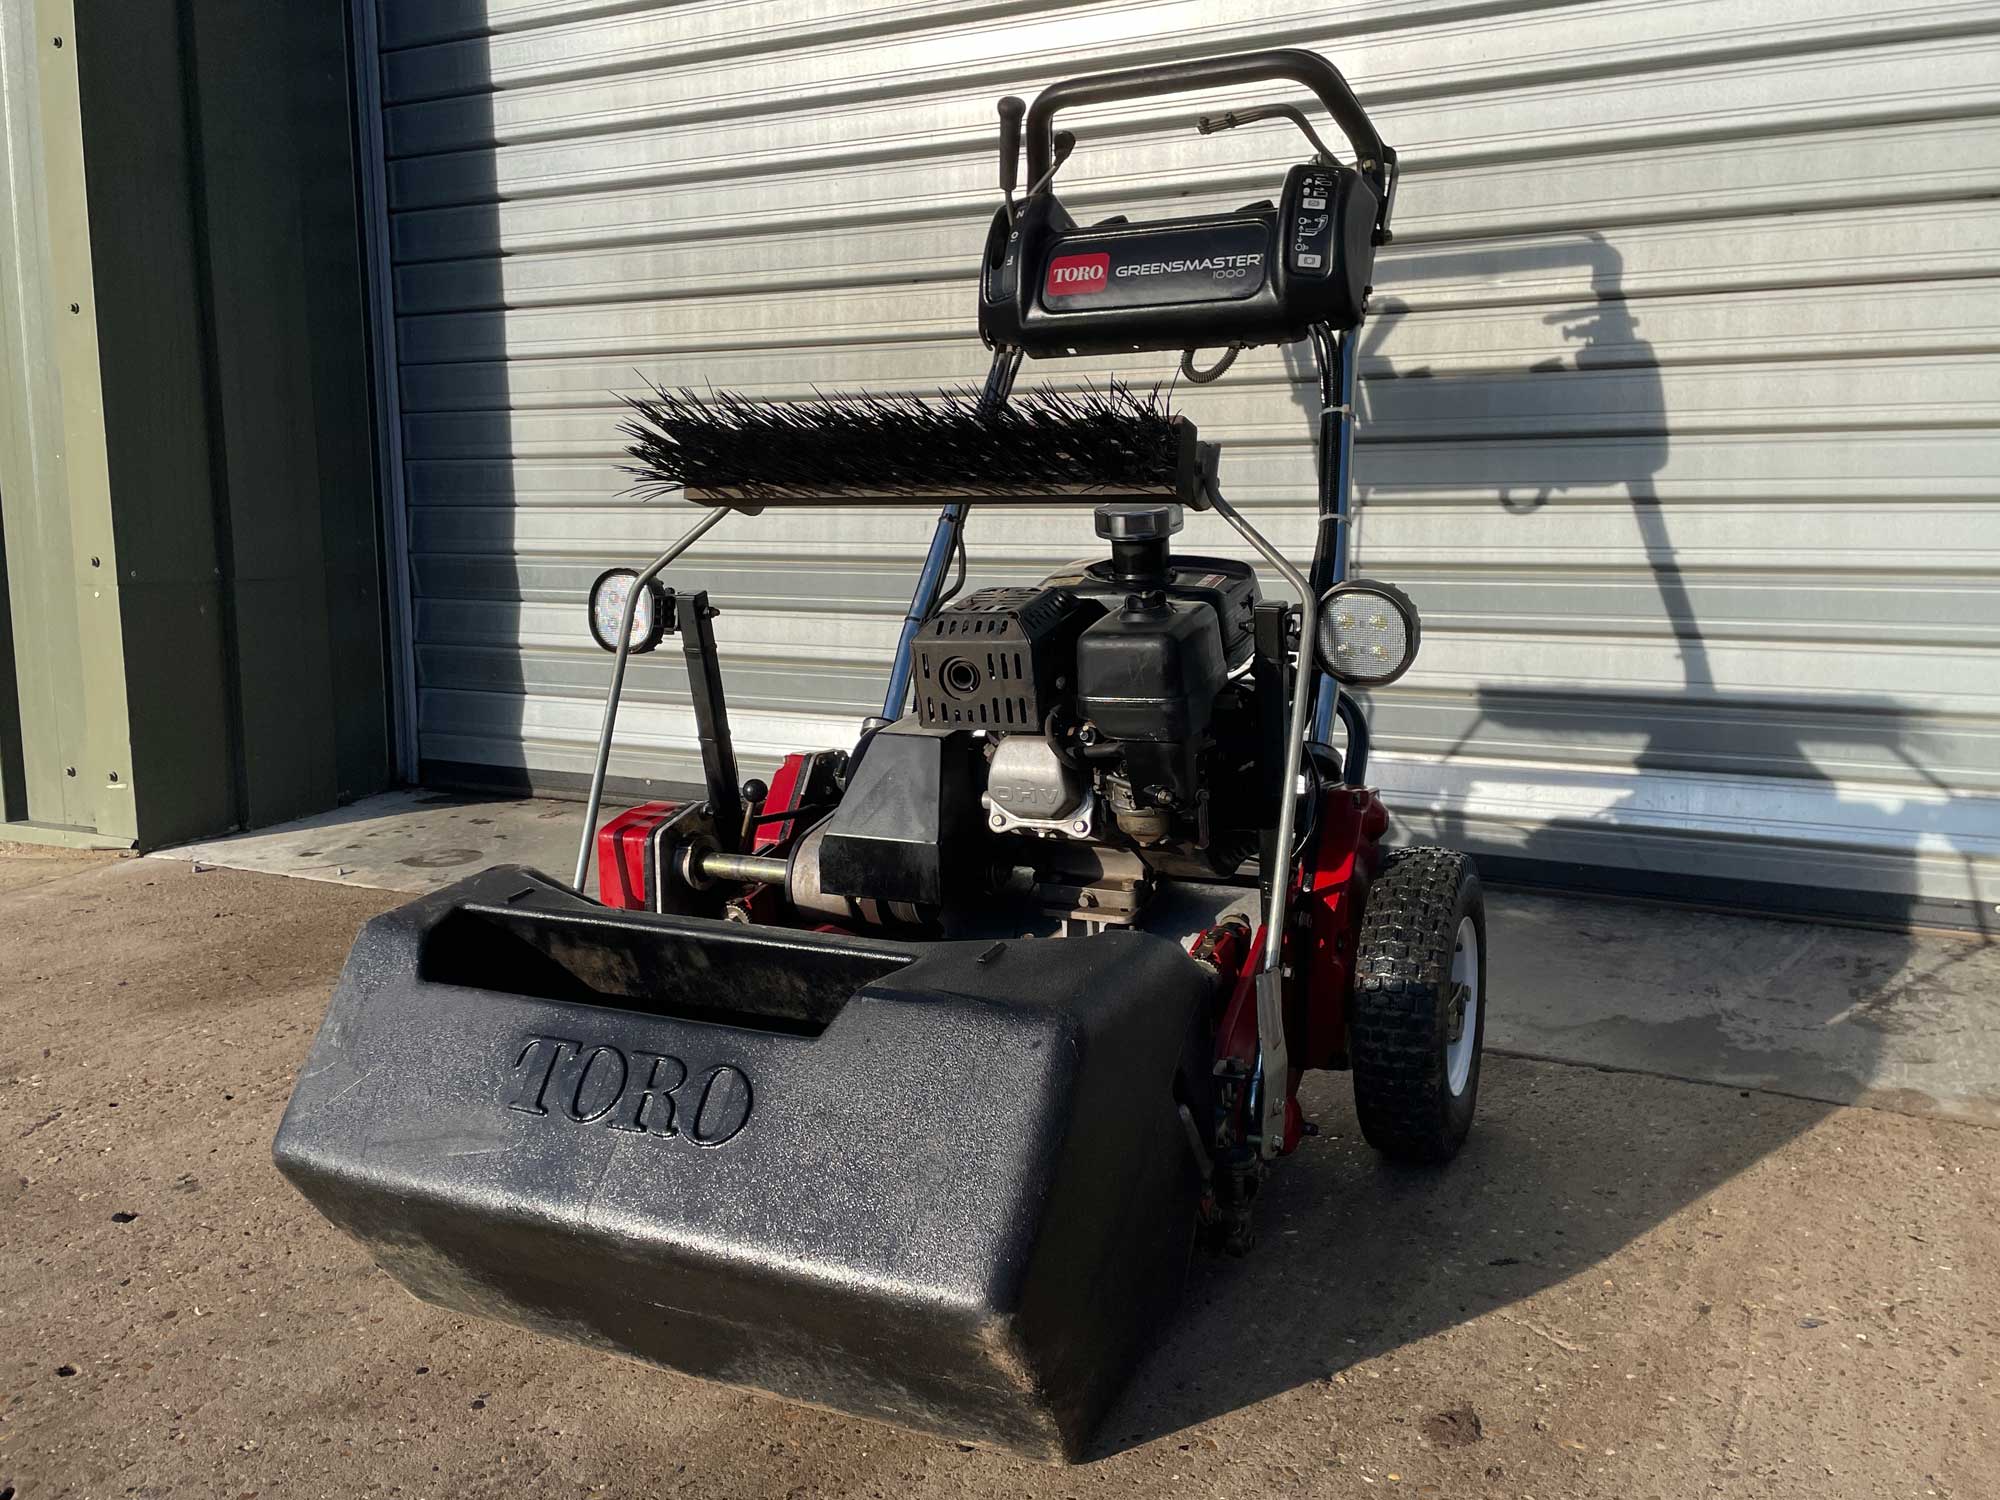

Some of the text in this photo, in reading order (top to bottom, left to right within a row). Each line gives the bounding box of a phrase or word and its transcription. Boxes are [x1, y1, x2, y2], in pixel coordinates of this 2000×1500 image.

[1053, 264, 1104, 284] TORO
[1115, 253, 1262, 278] GREENSMASTER
[1212, 268, 1246, 280] 1000
[993, 785, 1059, 805] OHV
[507, 1033, 754, 1149] TORO
